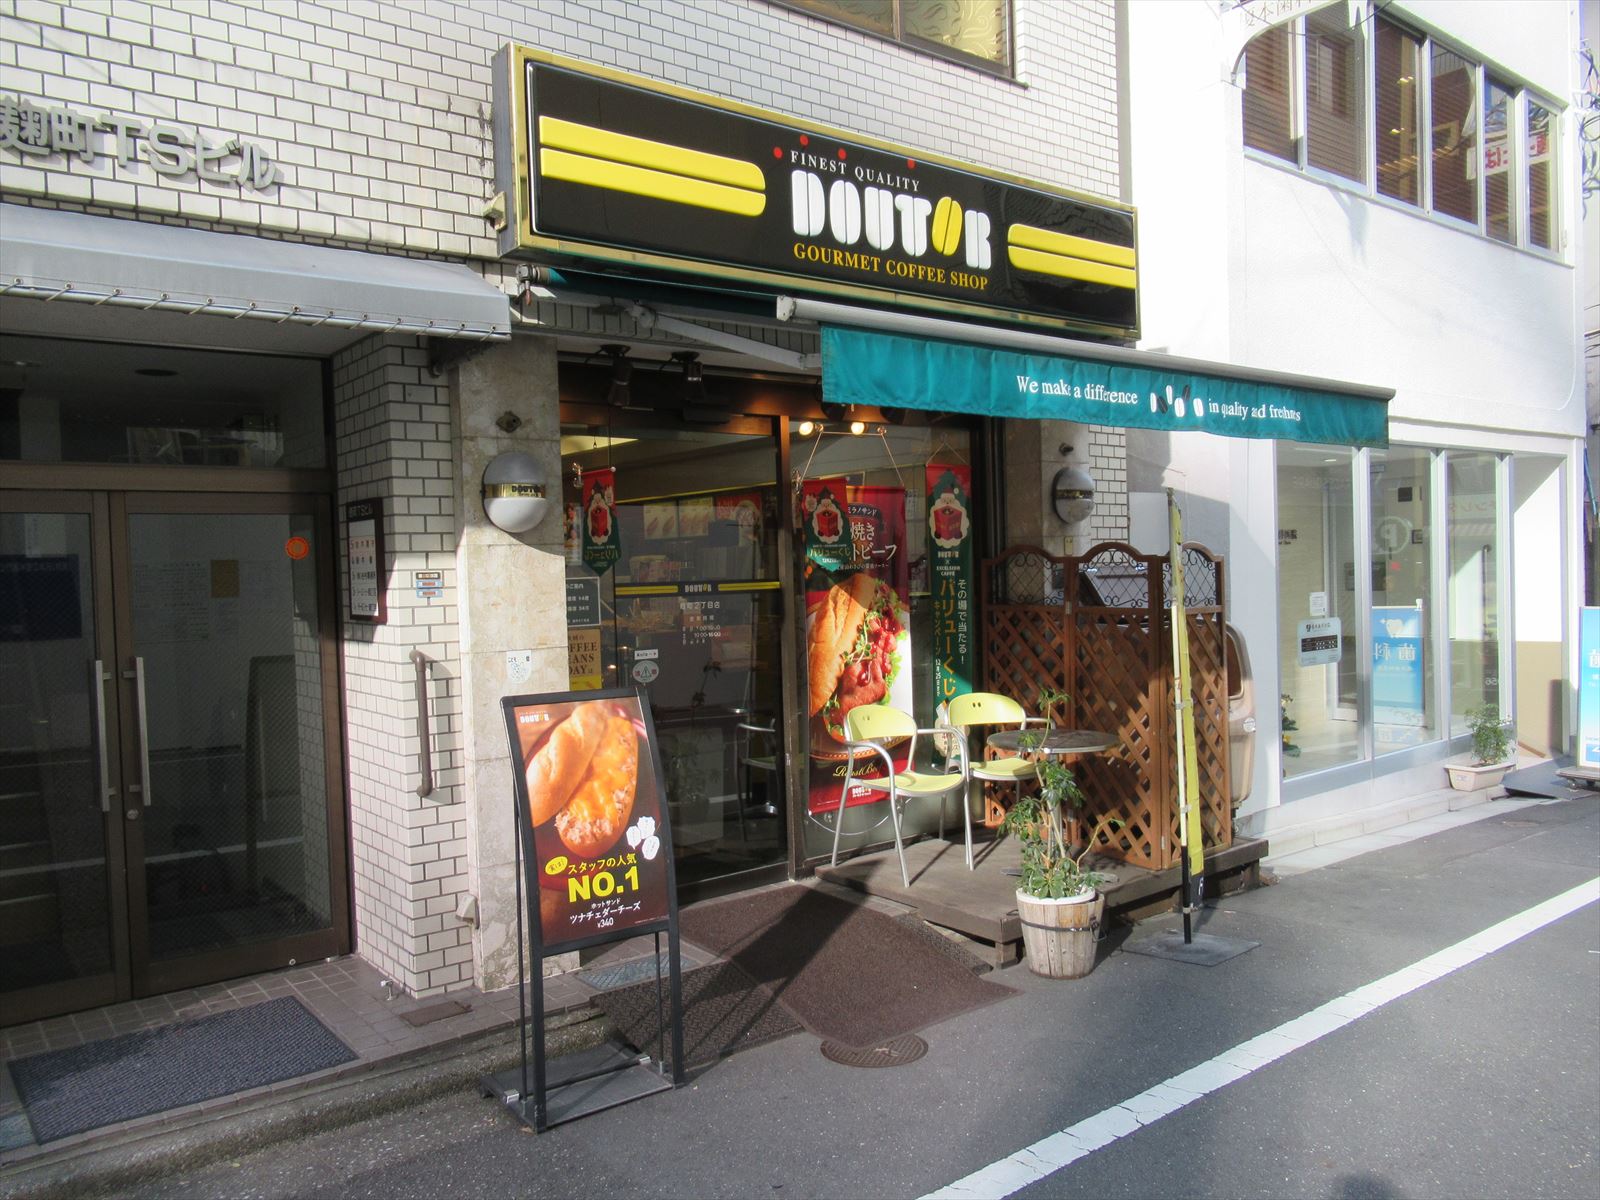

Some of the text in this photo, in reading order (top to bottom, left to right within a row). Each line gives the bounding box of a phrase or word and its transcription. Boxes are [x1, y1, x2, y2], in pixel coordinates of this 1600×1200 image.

[790, 149, 920, 192] FINEST QUALITY
[791, 169, 992, 270] DOUTOR
[793, 242, 988, 291] GOURMET COFFEE SHOP
[1016, 375, 1039, 394] We
[1041, 379, 1071, 396] make
[1073, 386, 1081, 399] a
[1208, 398, 1219, 413] in
[851, 521, 875, 541] 焼き
[940, 578, 957, 698] バリューくじ
[568, 853, 637, 875] スタッフの人気
[568, 865, 639, 903] NO.1
[569, 901, 641, 925] ツナチェダーチーズ
[591, 897, 621, 909] ホットサンド
